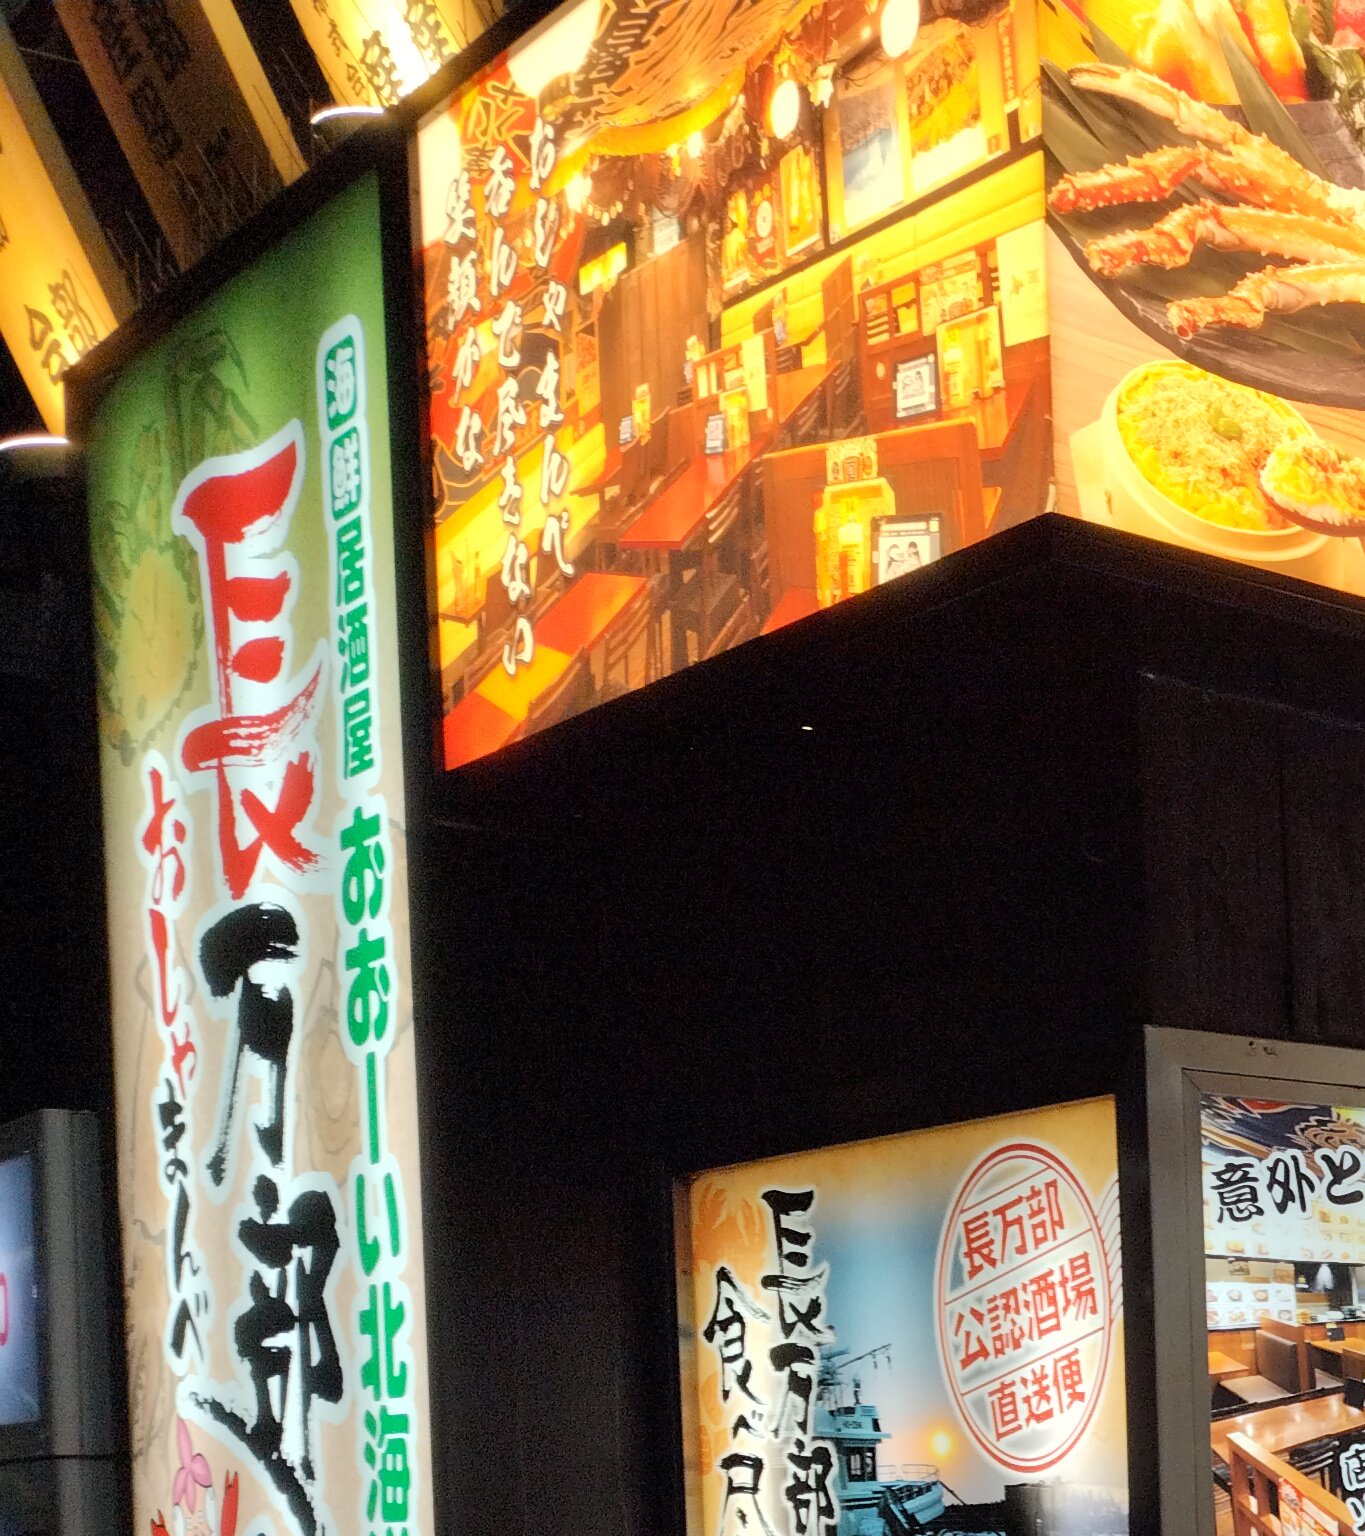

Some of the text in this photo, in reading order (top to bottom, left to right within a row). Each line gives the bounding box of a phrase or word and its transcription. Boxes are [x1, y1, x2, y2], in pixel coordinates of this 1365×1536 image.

[143, 766, 208, 1366] おしゃまんべ
[961, 1177, 1065, 1275] 長万部
[953, 1249, 1101, 1370] 公認酒場
[987, 1348, 1088, 1445] 直送便
